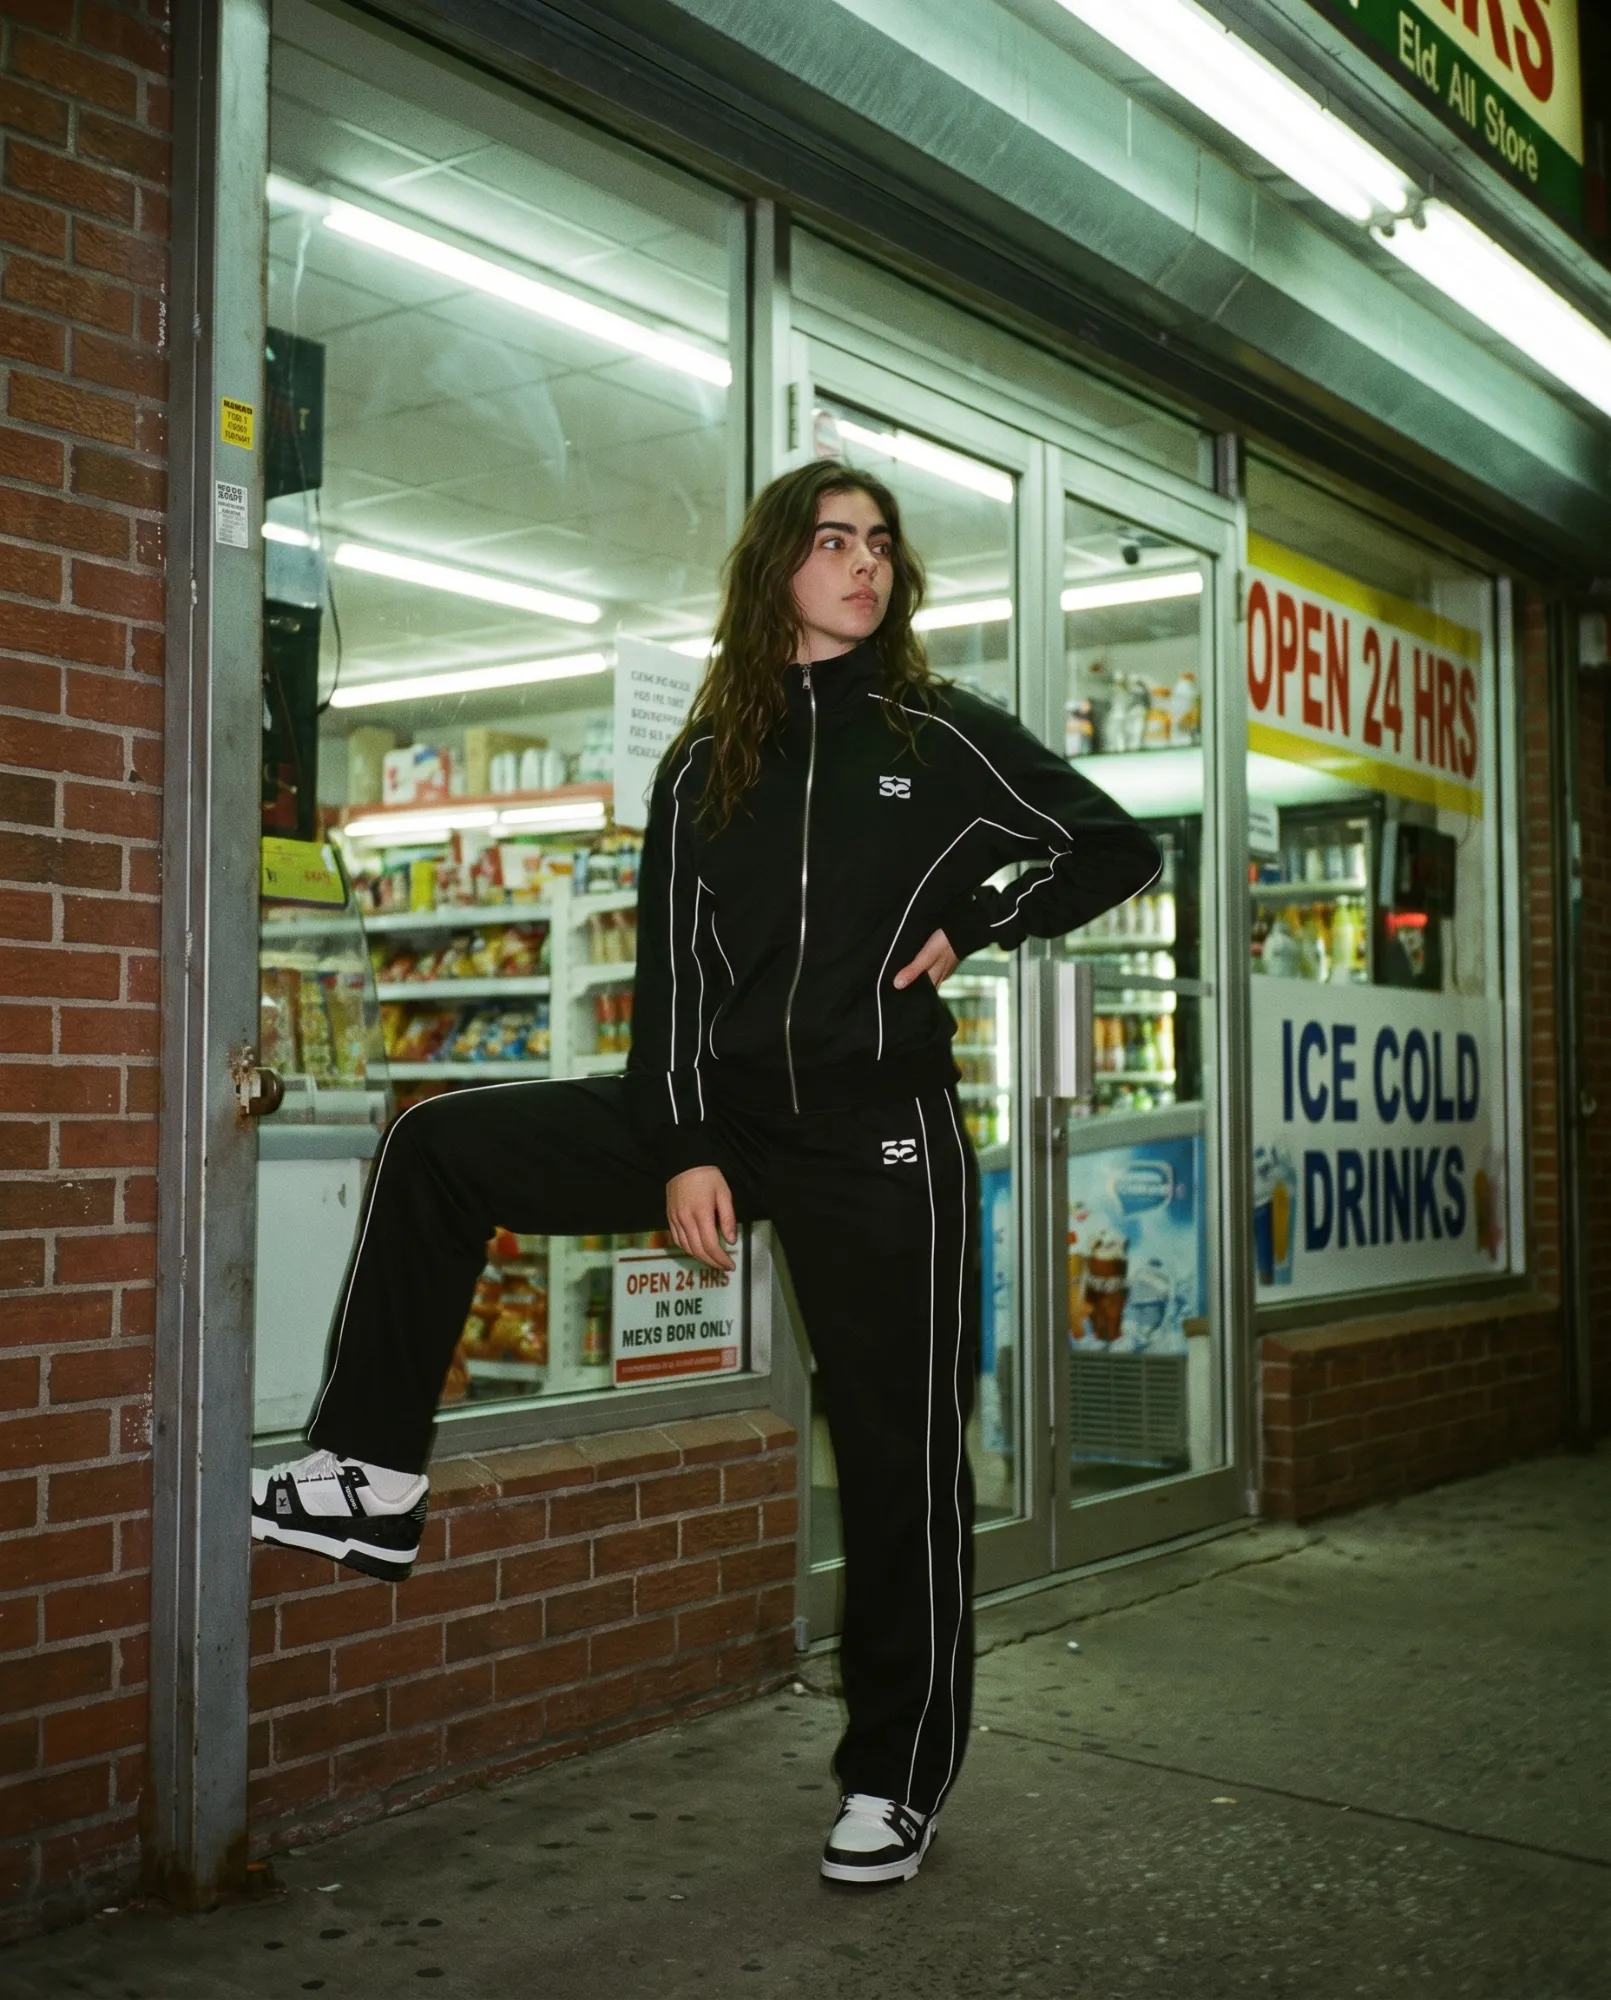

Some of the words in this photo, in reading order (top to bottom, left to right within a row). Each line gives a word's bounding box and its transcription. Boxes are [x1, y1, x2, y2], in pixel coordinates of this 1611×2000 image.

[1448, 62, 1476, 128] All
[1484, 93, 1538, 182] Store
[1247, 580, 1350, 737] OPEN
[1363, 626, 1403, 753] 24
[1413, 647, 1478, 780] HRS
[1282, 1019, 1358, 1124] ICE
[1373, 1025, 1480, 1124] COLD
[1304, 1145, 1467, 1253] DRINKS
[627, 1272, 670, 1295] OPEN
[675, 1270, 695, 1291] 24
[656, 1300, 670, 1318] IN
[674, 1298, 703, 1315] ONE
[700, 1319, 734, 1339] ONLY
